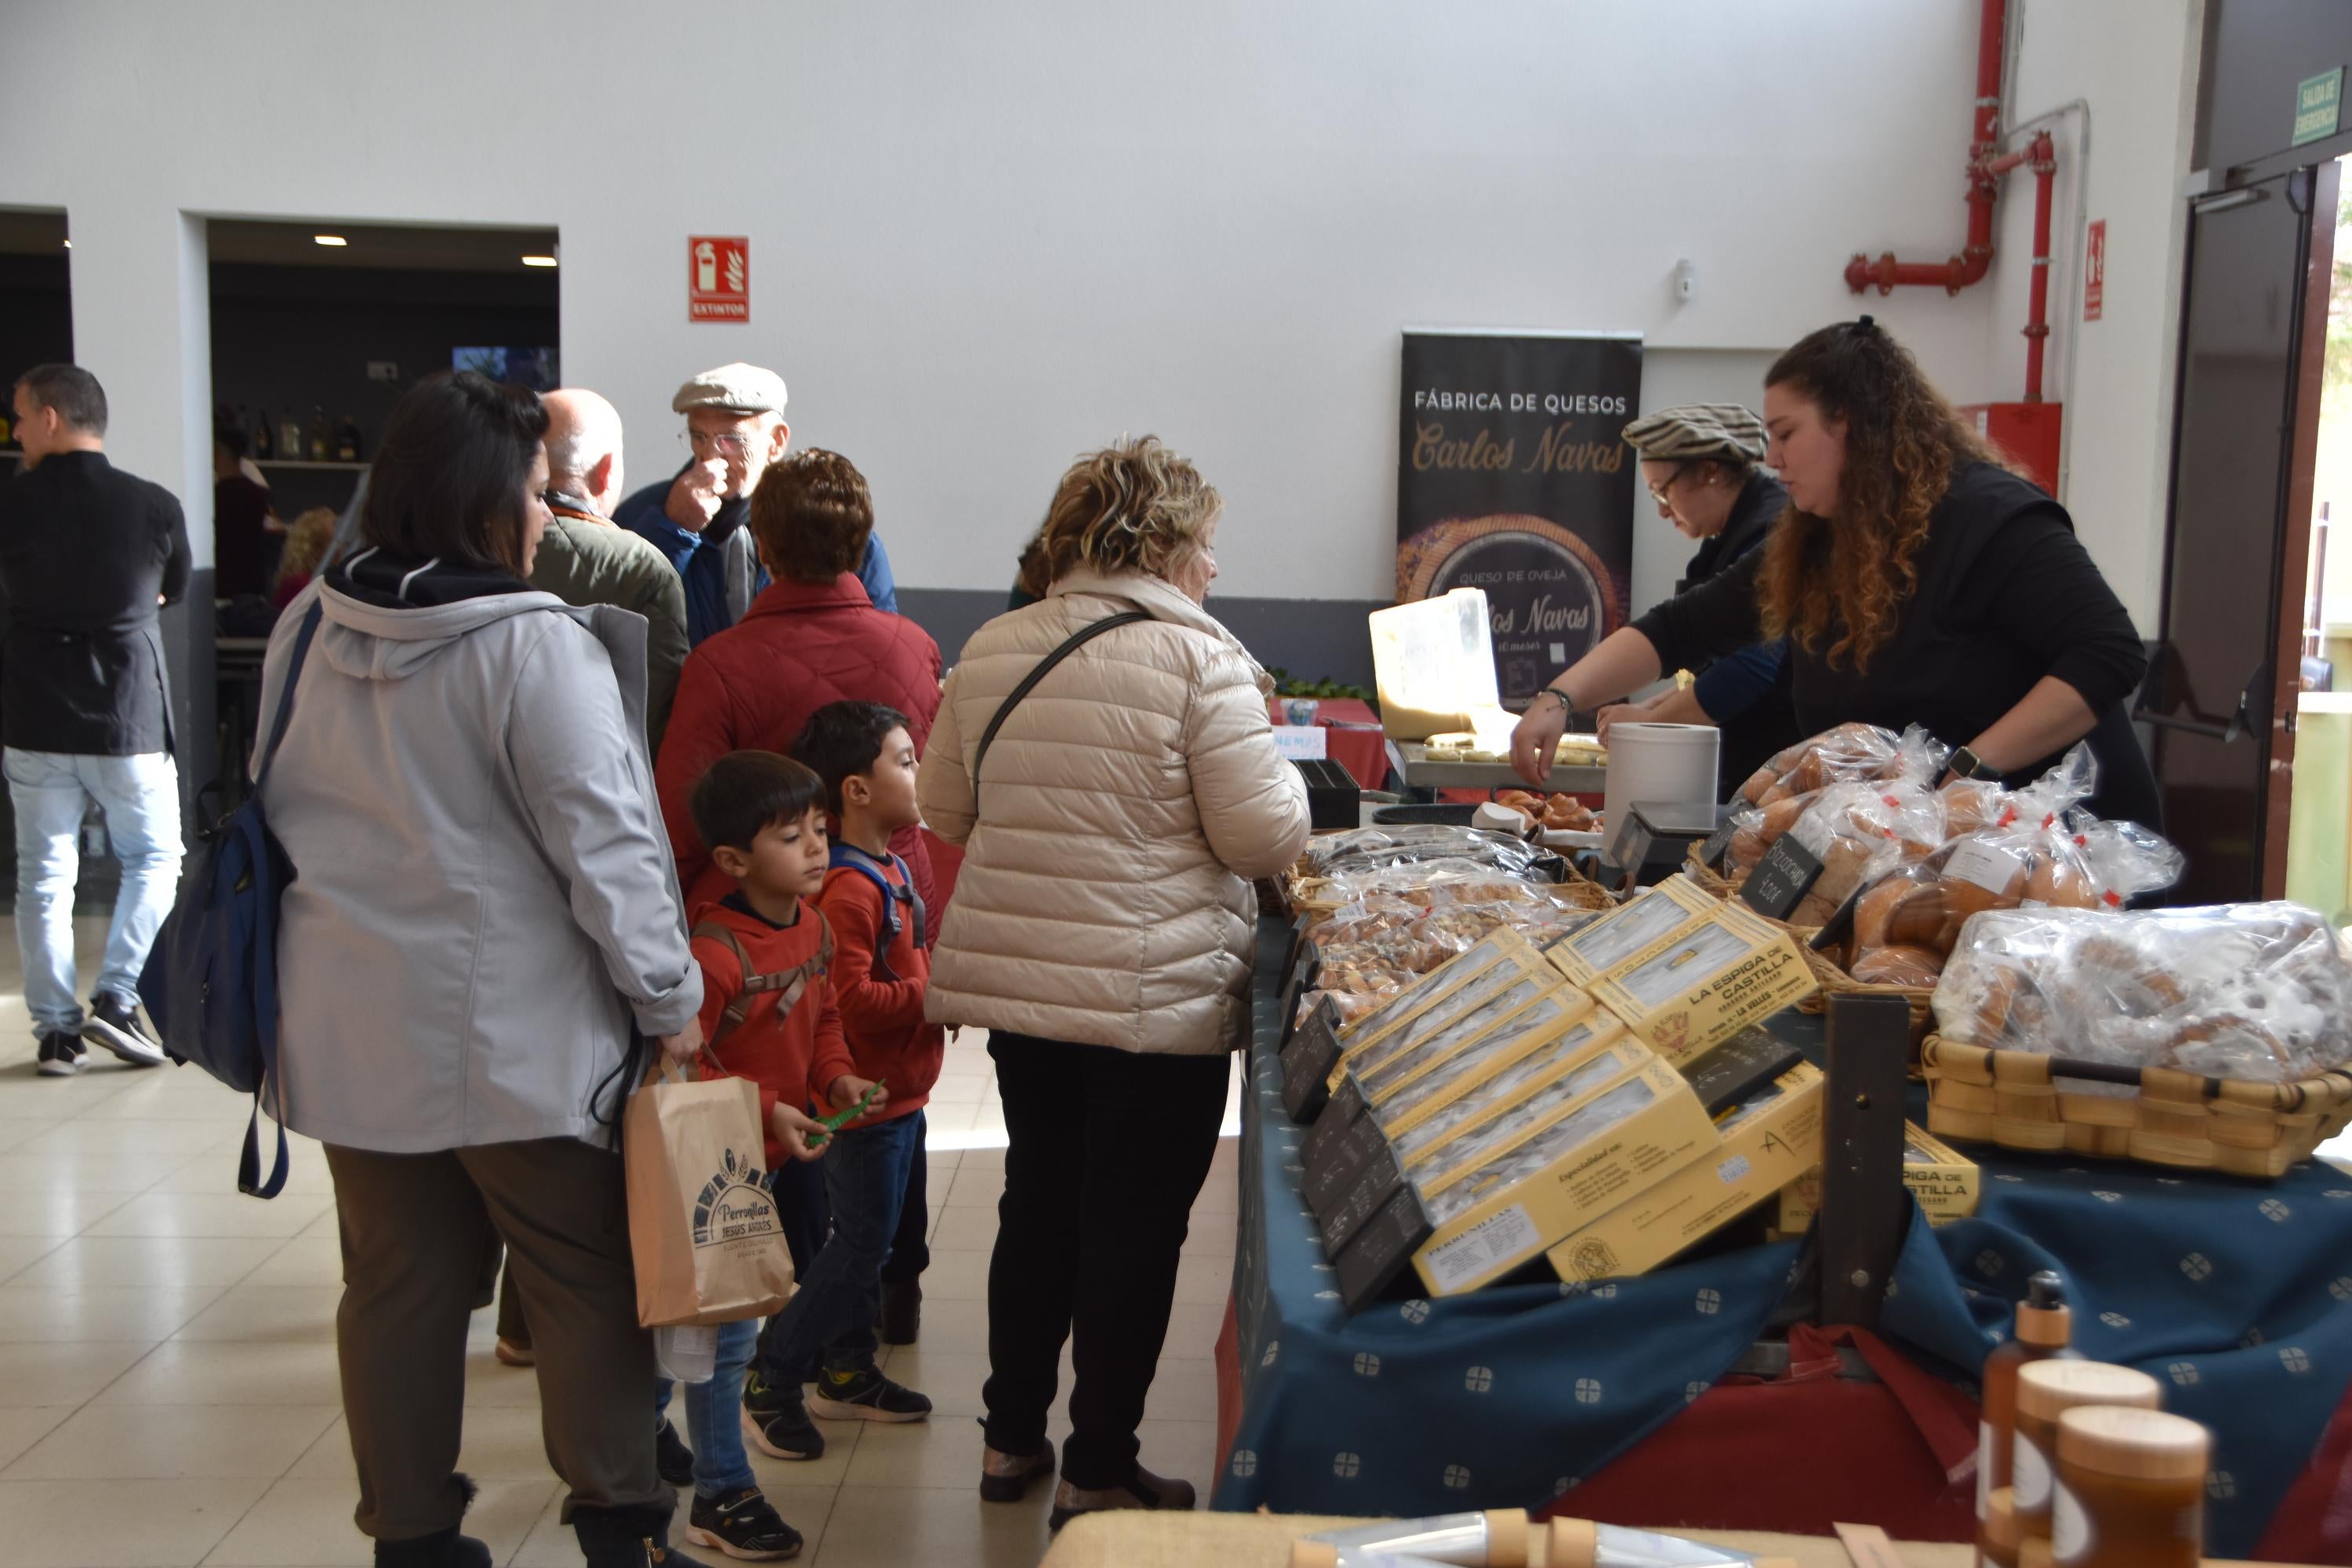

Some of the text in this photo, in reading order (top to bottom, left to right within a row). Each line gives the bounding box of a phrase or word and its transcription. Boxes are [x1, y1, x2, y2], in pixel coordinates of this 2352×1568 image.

[693, 302, 746, 315] EXTINTOR
[1414, 388, 1626, 416] FÁBRICA DE QUESOS
[1412, 418, 1625, 474] Carlos Navas
[1460, 570, 1567, 584] QUESO DE OVEJA
[1520, 593, 1590, 635] Navas
[1689, 946, 1782, 1006] LA ESPIGA DE
[1722, 953, 1793, 1000] CASTILLA
[1903, 1171, 1940, 1181] PIGA
[1907, 1185, 1966, 1195] STILLA
